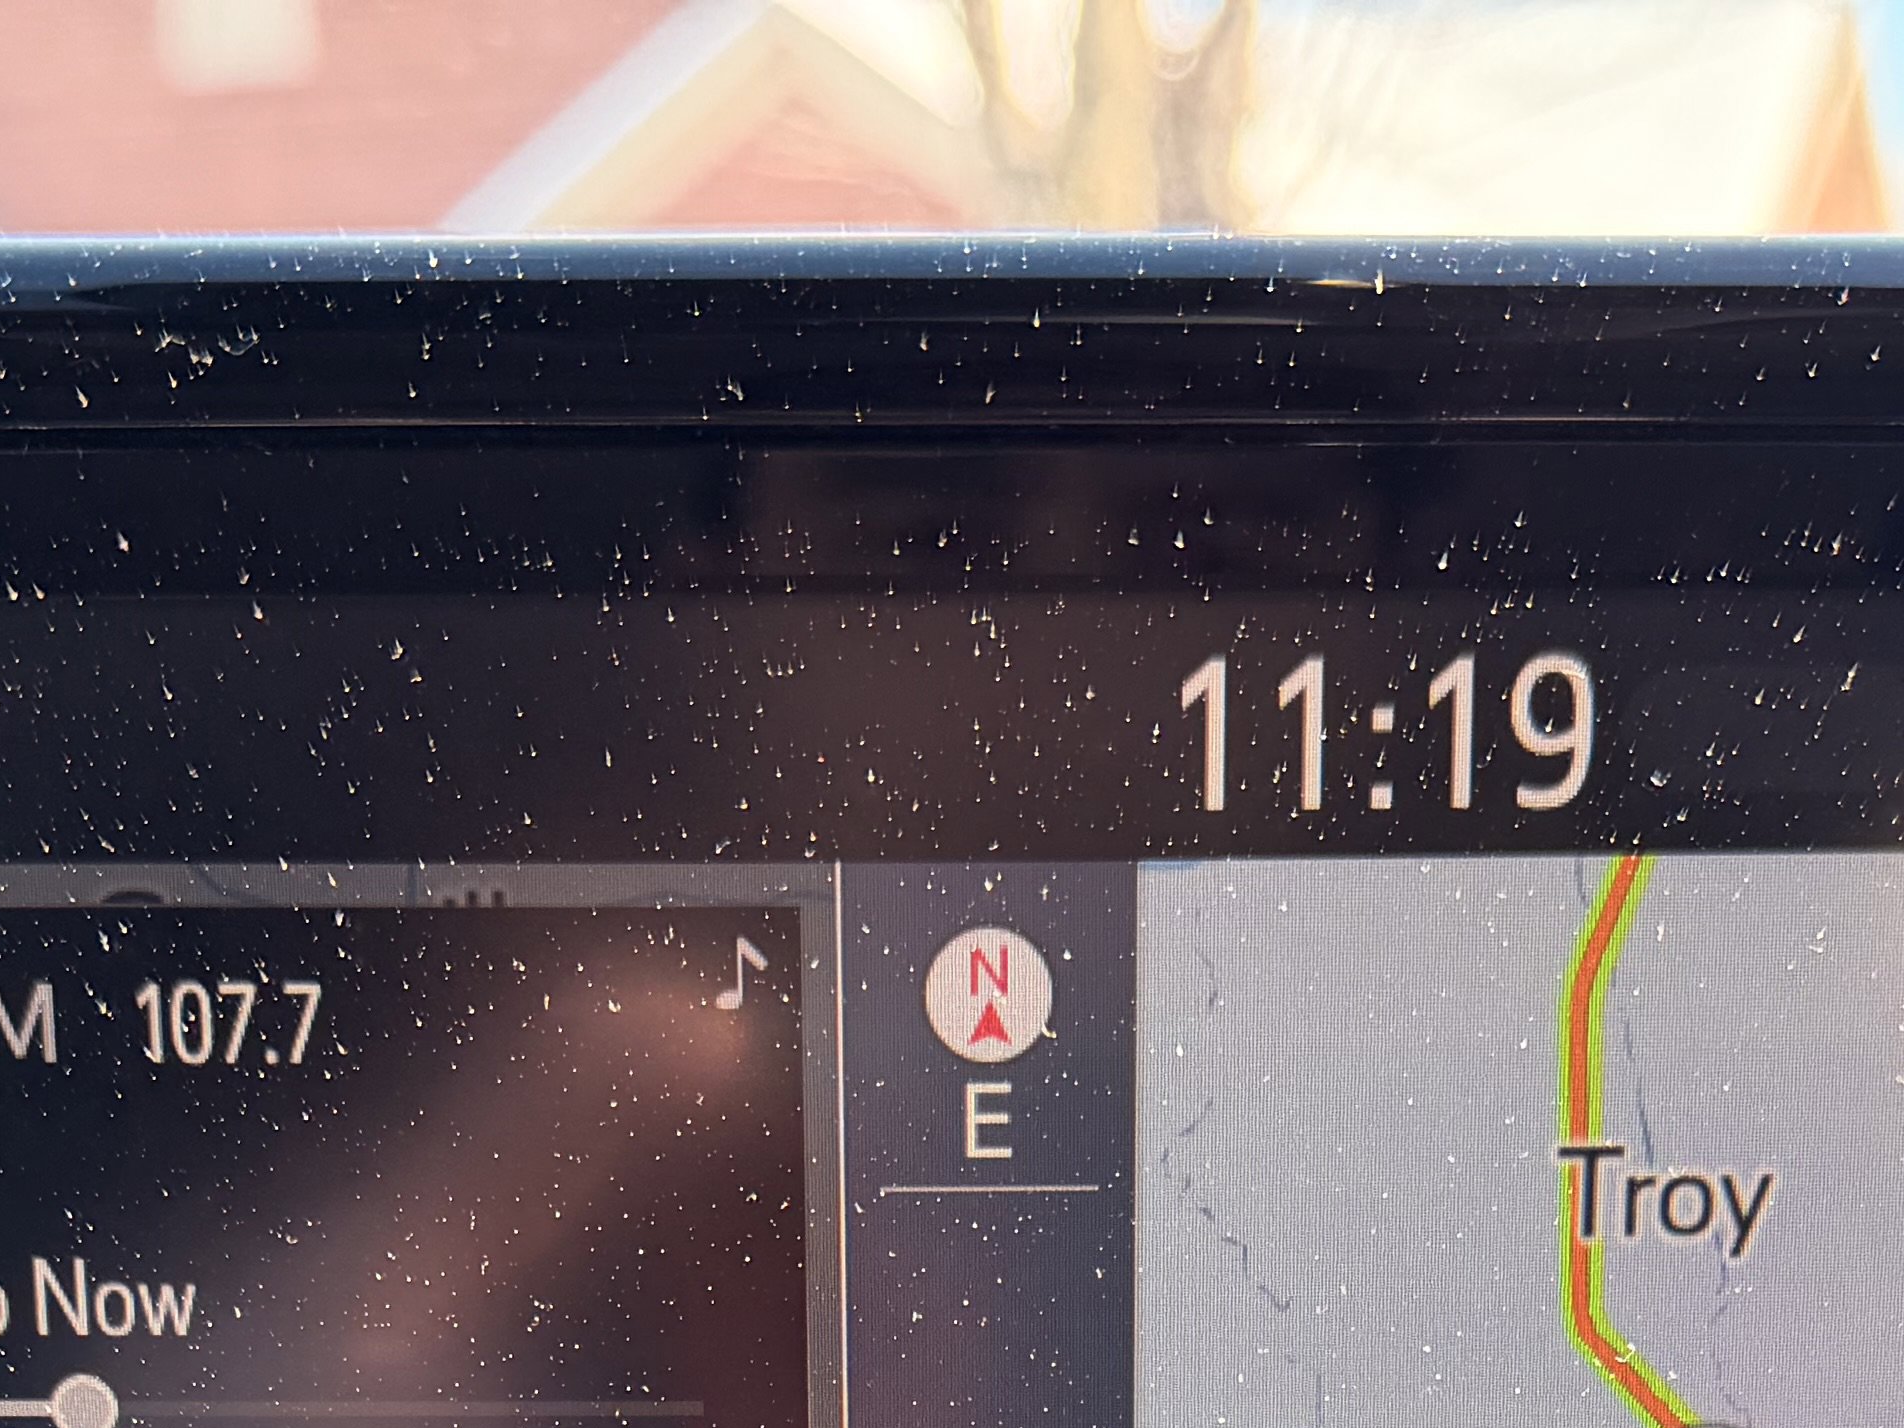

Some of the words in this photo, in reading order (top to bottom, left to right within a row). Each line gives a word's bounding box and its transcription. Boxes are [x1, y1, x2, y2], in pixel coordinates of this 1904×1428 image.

[1180, 652, 1595, 812] 11:19
[970, 943, 1009, 998] N
[136, 982, 323, 1066] 107.7
[965, 1081, 1013, 1159] E
[1558, 1144, 1774, 1258] Troy
[32, 1255, 196, 1338] Now
